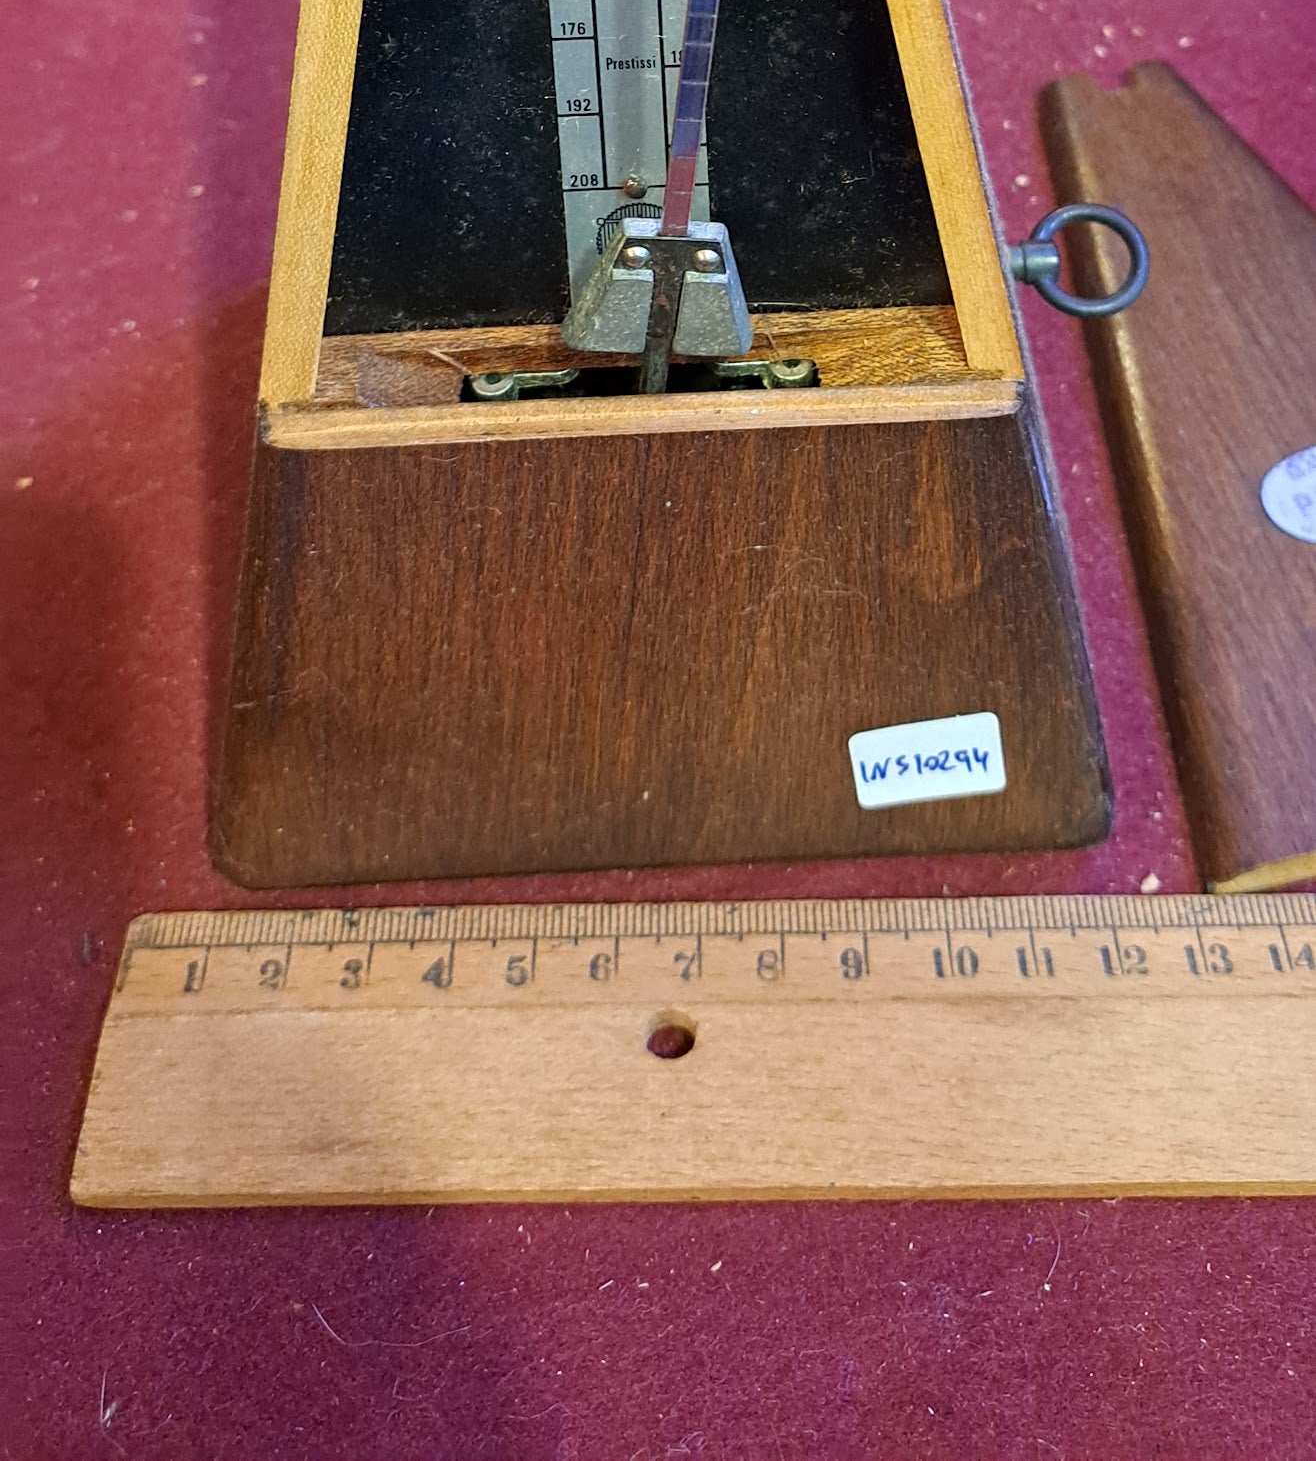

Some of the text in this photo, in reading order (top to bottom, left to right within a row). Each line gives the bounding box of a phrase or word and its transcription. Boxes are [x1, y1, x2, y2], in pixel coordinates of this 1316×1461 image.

[560, 22, 586, 36] 176
[606, 56, 656, 71] Prestissi
[566, 99, 591, 112] 192
[570, 174, 599, 188] 208
[184, 960, 200, 993] 1
[259, 959, 284, 990] 2
[339, 958, 364, 989] 3
[422, 957, 452, 989] 4
[505, 954, 529, 986] 5
[589, 952, 612, 982] 6
[673, 951, 697, 981] 7
[756, 949, 780, 982] 8
[839, 947, 864, 979] 9
[933, 945, 979, 978] 10
[1016, 946, 1054, 977] 11
[1100, 944, 1148, 976] 12
[1184, 943, 1234, 975] 13
